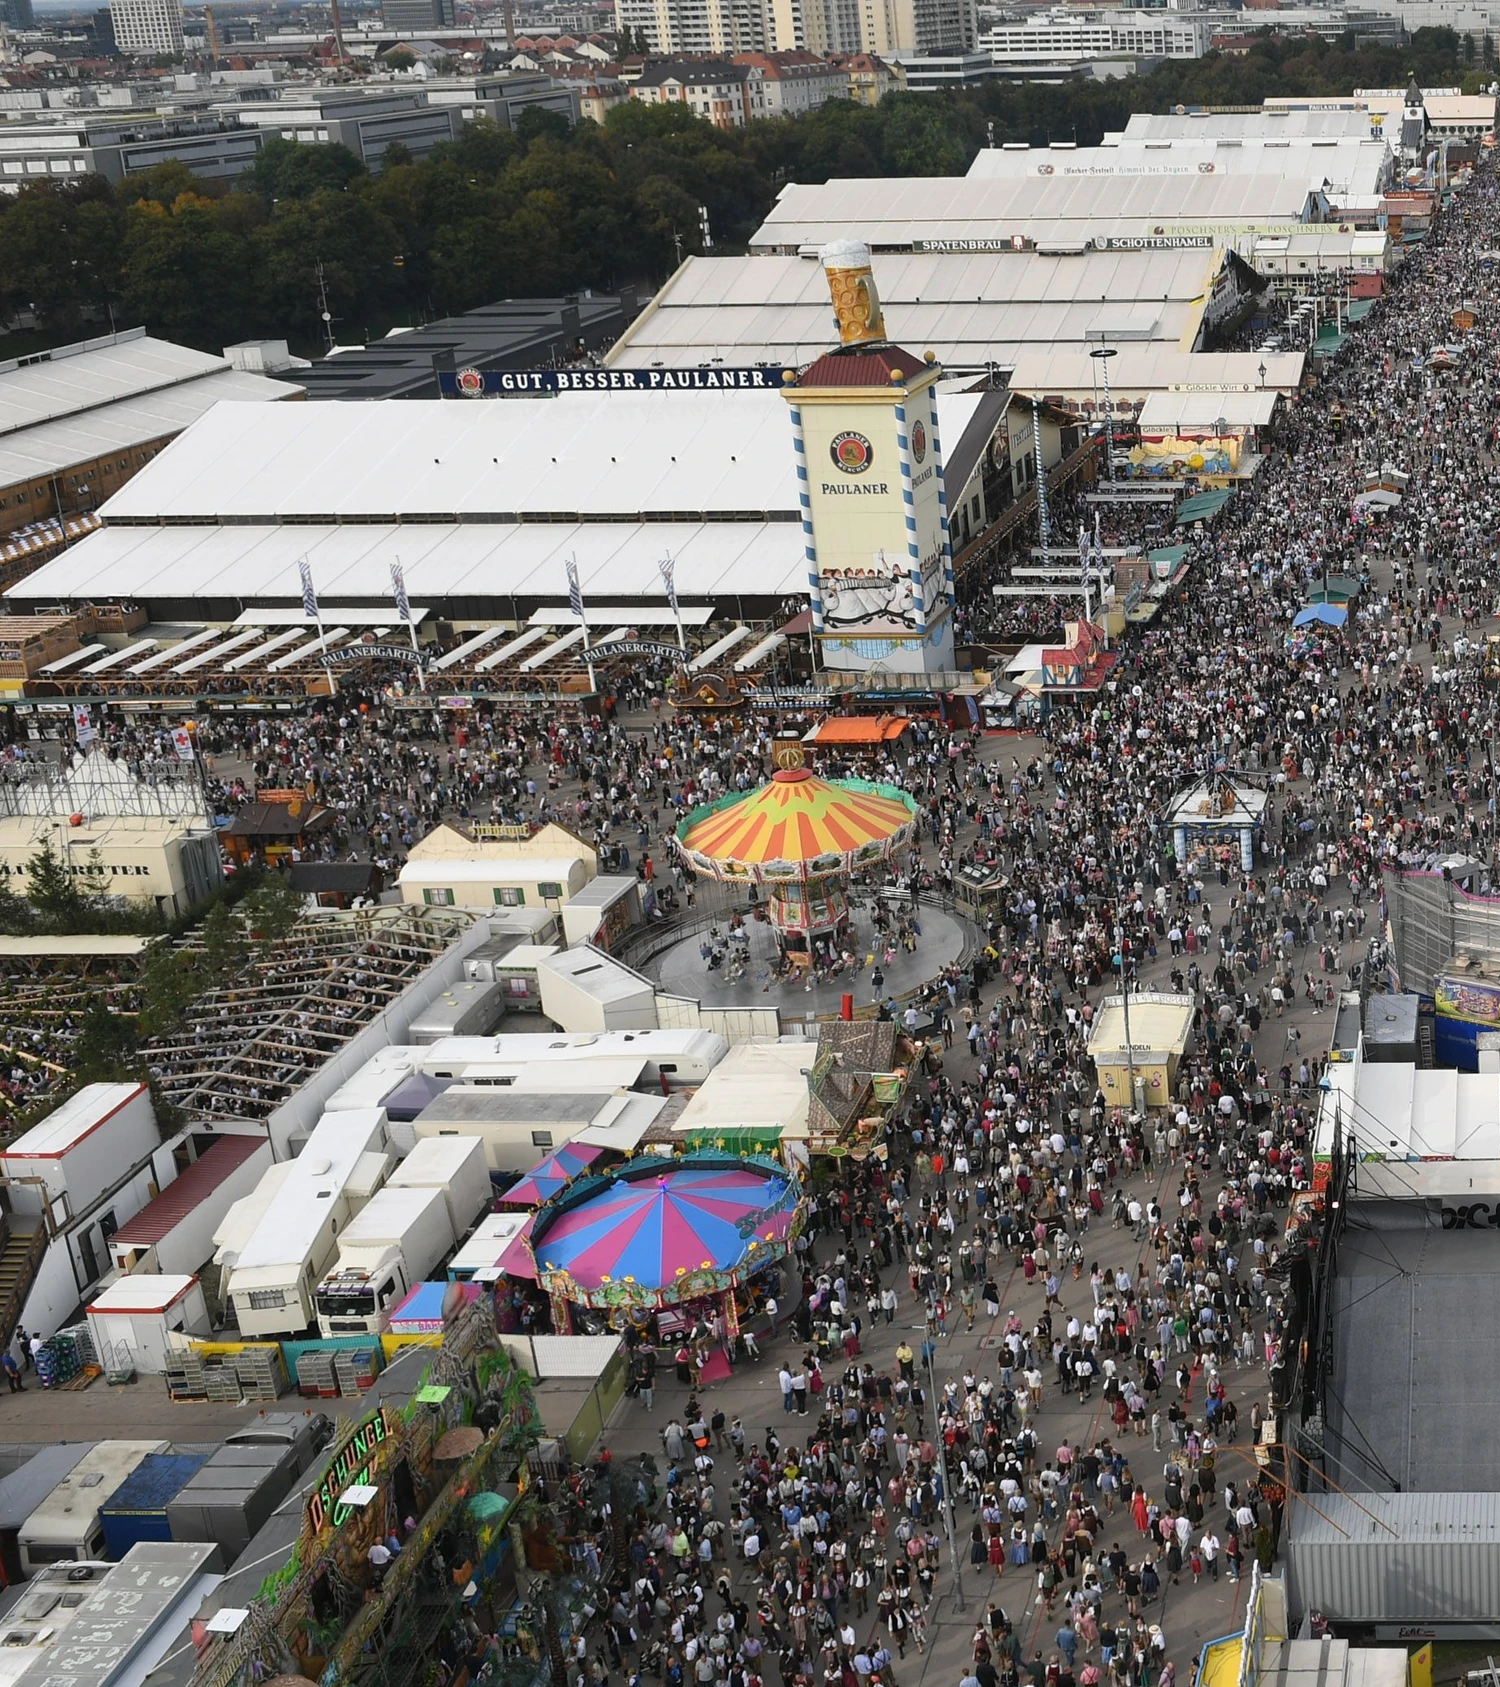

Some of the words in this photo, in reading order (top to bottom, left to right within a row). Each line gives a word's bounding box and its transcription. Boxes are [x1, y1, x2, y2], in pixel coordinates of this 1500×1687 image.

[1171, 225, 1236, 235] POSCHNER'S
[1267, 224, 1332, 234] POSCHNER'S
[922, 239, 1001, 250] SPATENBRÄU
[1112, 236, 1211, 248] SCHOTTENHAMEL
[501, 373, 551, 391] GUT,
[558, 373, 645, 390] BESSER,
[651, 371, 773, 389] PAULANER.
[832, 432, 870, 449] PAULANER
[837, 461, 869, 473] MÜNCHEN
[821, 483, 890, 495] PAULANER
[320, 647, 424, 666] PAULANERGARTEN
[583, 643, 687, 662] PAULANERGARTEN
[308, 1407, 393, 1536] DSCHUNGEL
